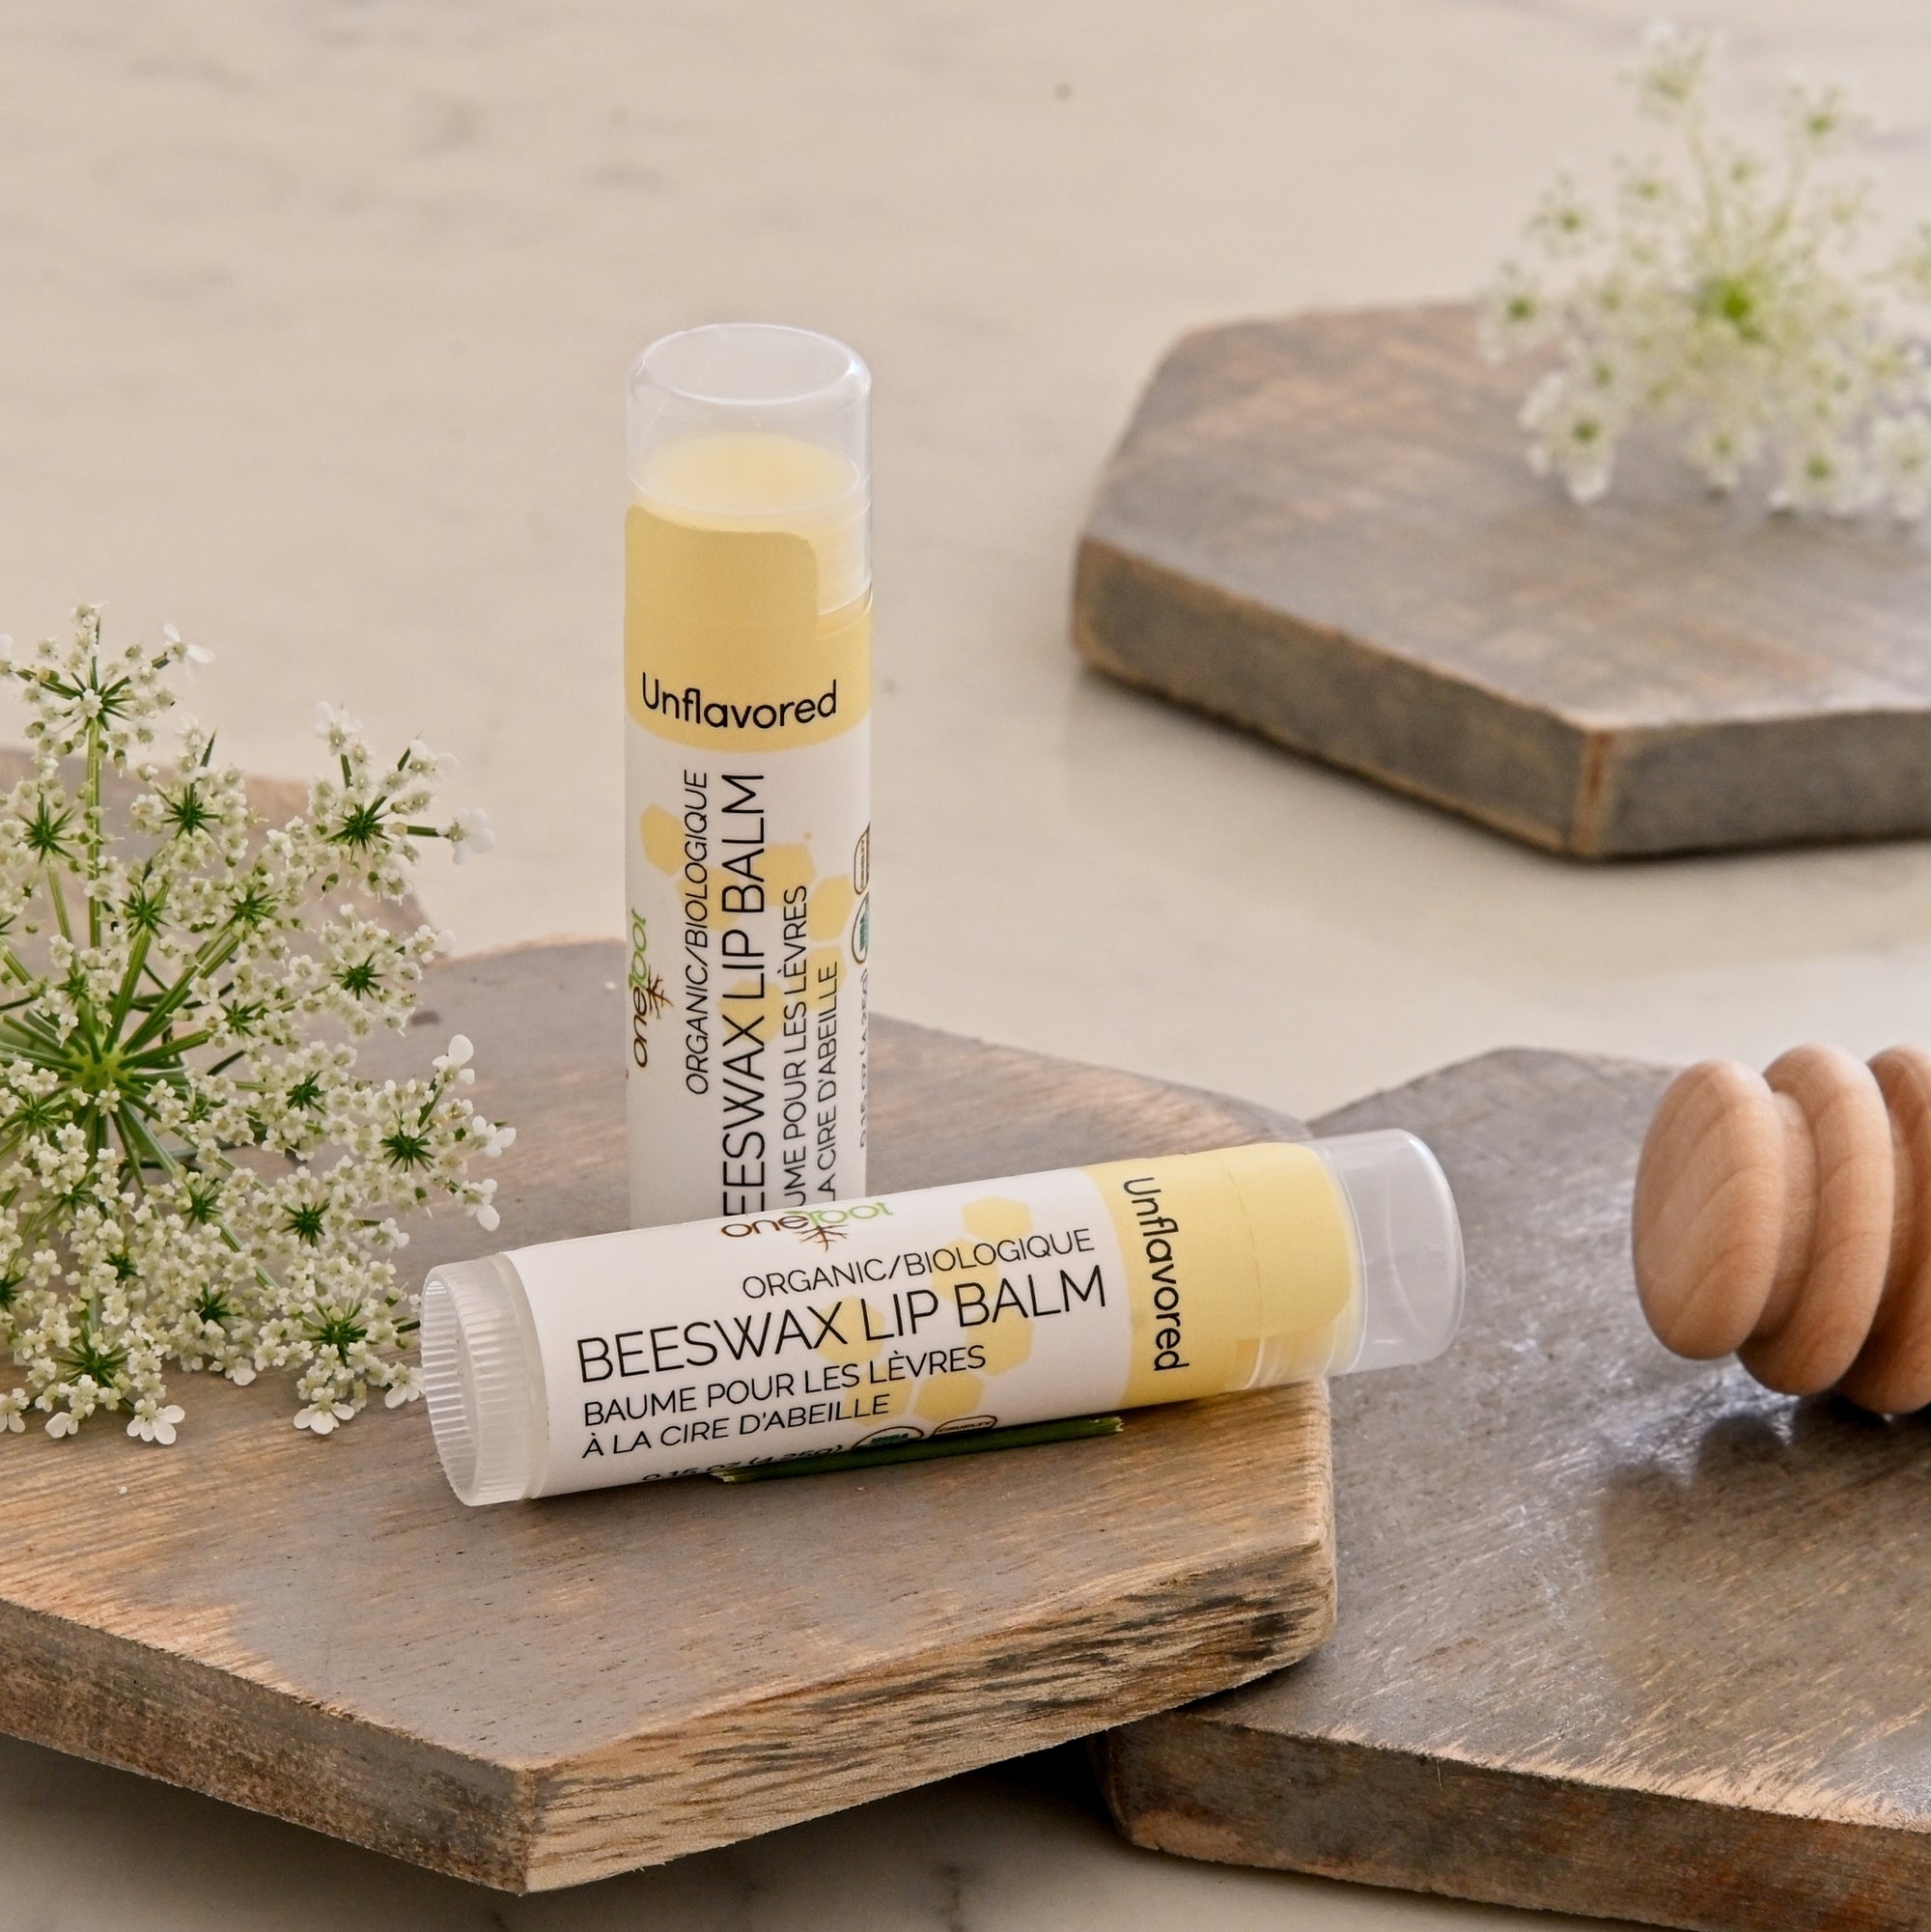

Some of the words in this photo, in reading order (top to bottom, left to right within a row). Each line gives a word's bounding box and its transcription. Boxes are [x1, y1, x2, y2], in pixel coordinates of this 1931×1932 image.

[641, 672, 838, 730] Unflavored
[720, 774, 765, 912] BALM
[684, 769, 709, 1095] ORGANIC/BIOLOGIQUE
[721, 929, 765, 998] LIP
[777, 884, 807, 995] LÈVRES
[783, 1001, 807, 1054] LES
[817, 961, 838, 1103] D'ABEILLE
[721, 1015, 766, 1216] EESWAX
[783, 1060, 807, 1140] POUR
[817, 1106, 837, 1170] CIRE
[783, 1146, 807, 1207] UME
[742, 1227, 1096, 1300] ORGANIC/BIOLOGIQUE
[1123, 1177, 1190, 1372] Unflavored
[576, 1301, 849, 1384] BEESWAX
[860, 1288, 939, 1342] LIP
[954, 1264, 1106, 1328] BALM
[581, 1432, 604, 1459] À
[612, 1430, 652, 1455] LA
[659, 1417, 730, 1447] CIRE
[739, 1393, 891, 1435] D'ABEILLE
[583, 1386, 697, 1427] BAUME
[707, 1372, 795, 1408] POUR
[804, 1362, 861, 1394] LES
[869, 1344, 987, 1385] LÈVRES
